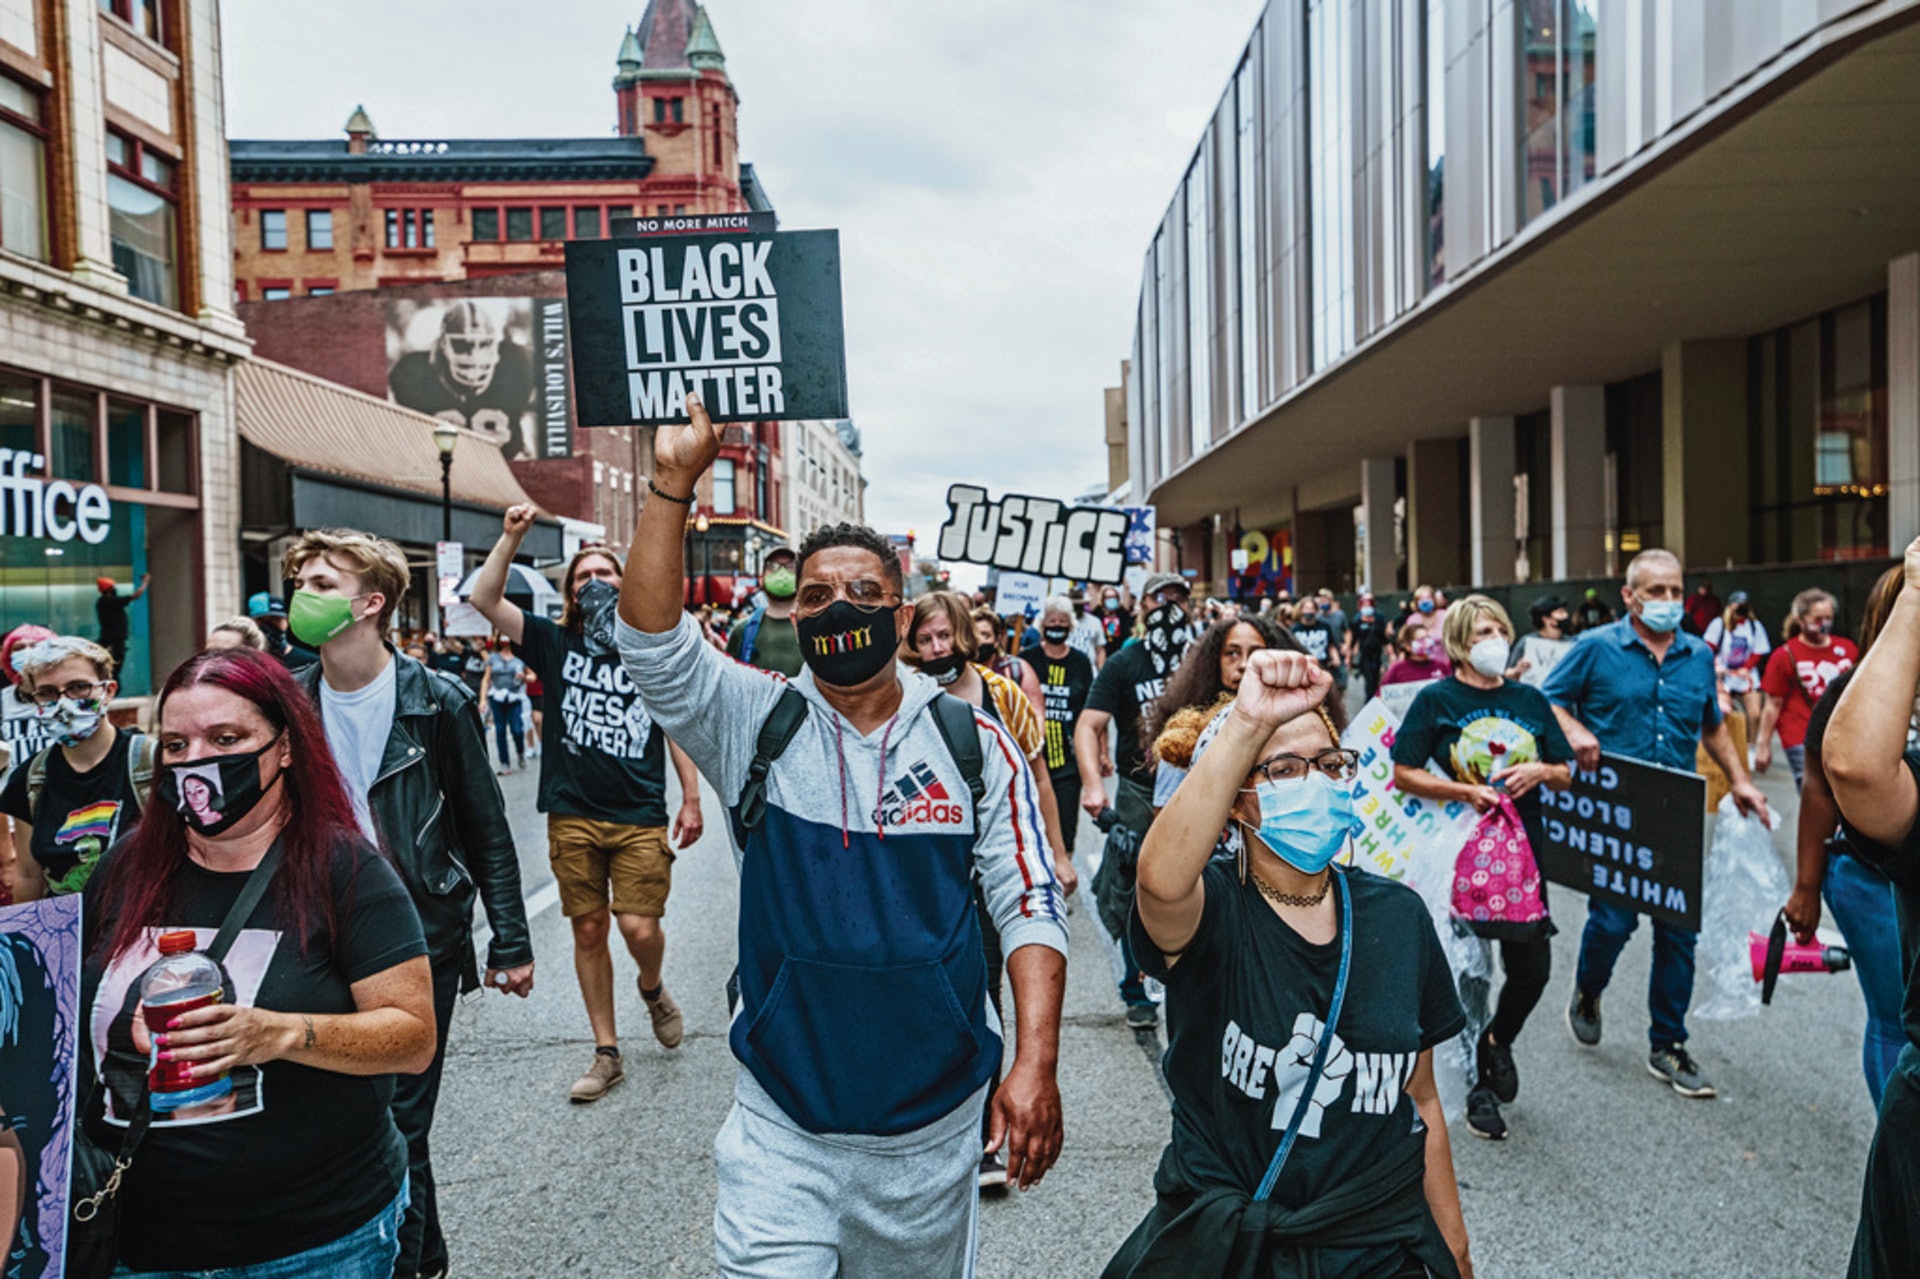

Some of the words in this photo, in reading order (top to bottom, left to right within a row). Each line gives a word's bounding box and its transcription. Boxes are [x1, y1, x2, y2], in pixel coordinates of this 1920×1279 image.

[637, 219, 659, 232] NO
[663, 218, 702, 230] MORE
[706, 216, 749, 228] MITCH
[617, 240, 777, 303] BLACK
[632, 302, 771, 365] LIVES
[544, 362, 568, 457] LOUISVILLE
[627, 365, 785, 420] MATTER
[939, 484, 1130, 584] JUSTICE
[871, 799, 963, 826] adidas
[1539, 783, 1632, 830] BLOCK
[1541, 815, 1655, 871] SILENC
[1592, 863, 1688, 914] WHITE
